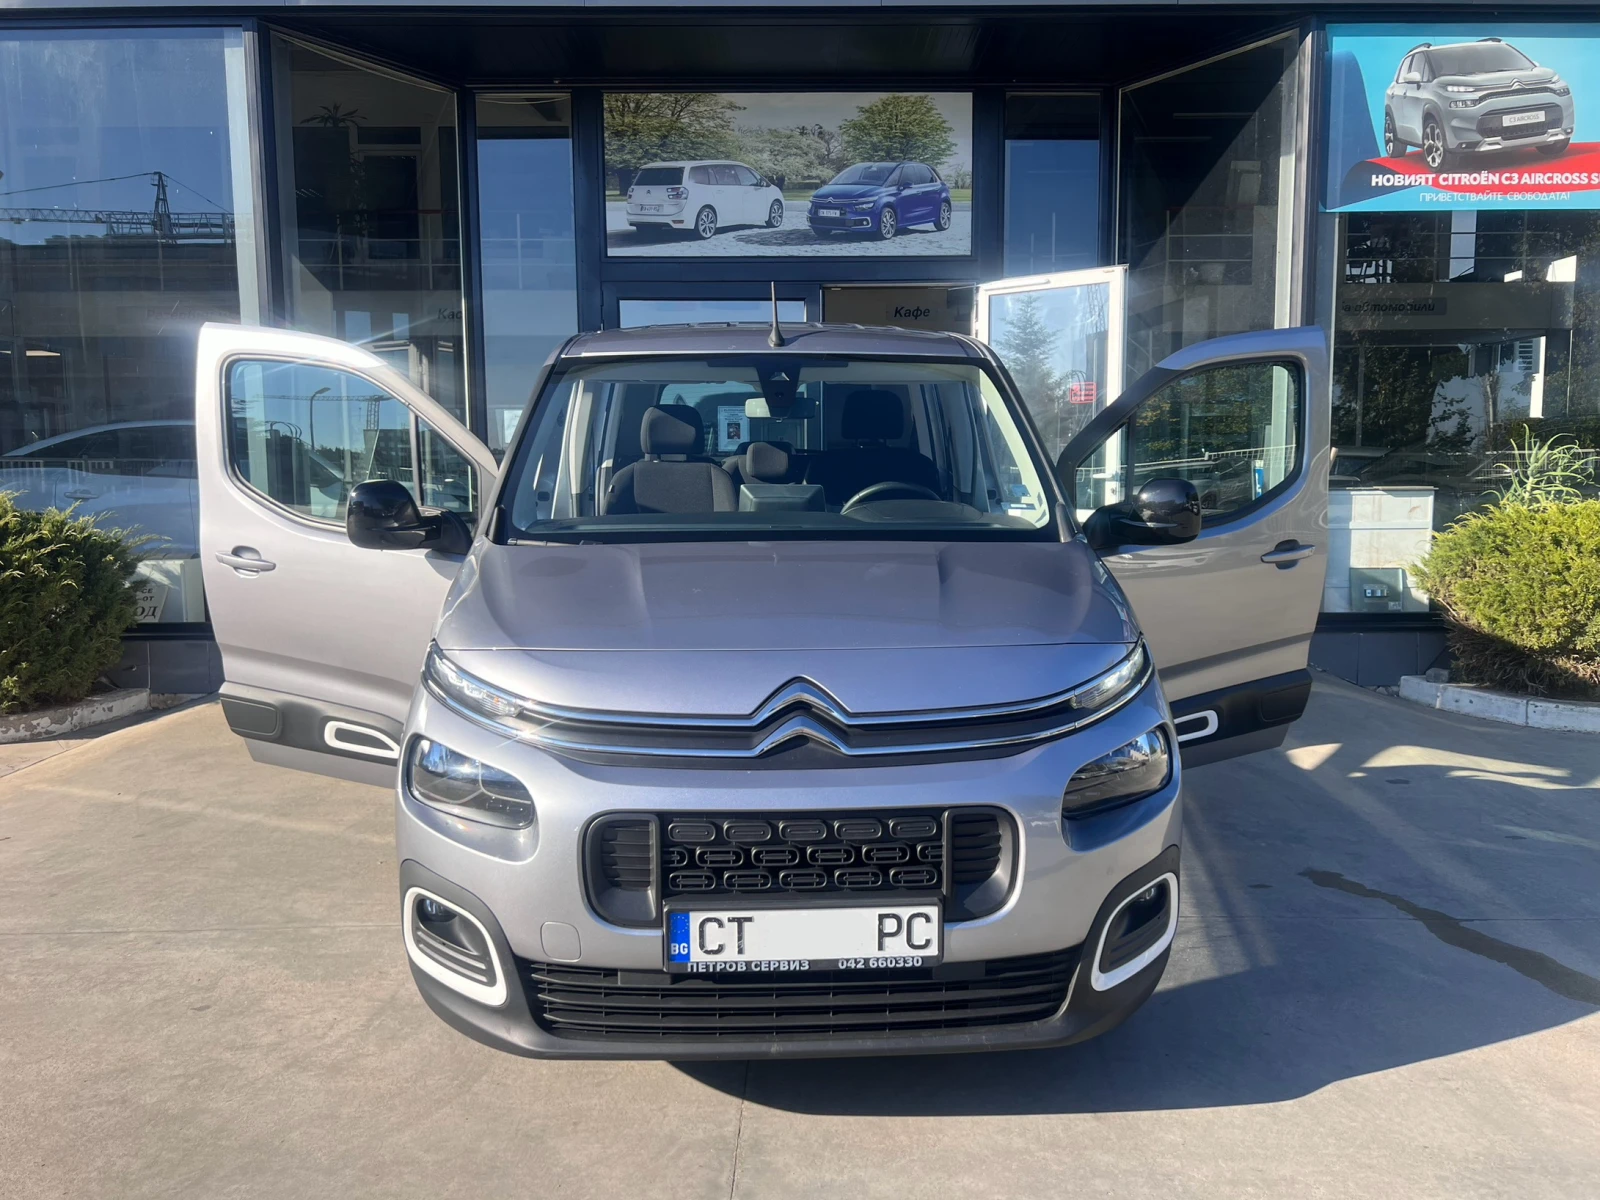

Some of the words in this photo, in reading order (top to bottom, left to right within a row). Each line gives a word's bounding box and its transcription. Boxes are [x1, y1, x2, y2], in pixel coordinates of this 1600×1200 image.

[1371, 174, 1435, 186] НОВИЯТ
[1438, 171, 1499, 185] CITROËN
[1501, 173, 1518, 185] C3
[1521, 172, 1588, 185] AIRCROSS
[1590, 172, 1600, 185] S
[1420, 190, 1503, 202] ПРИВЕТСТВАЙТЕ
[1507, 191, 1570, 201] СВОБОДАТА!
[893, 305, 930, 320] Кафе
[135, 606, 158, 619] ОД
[671, 943, 688, 955] BG
[687, 961, 747, 973] ПЕТРОВ
[751, 960, 810, 972] СЕРВИЗ
[838, 958, 865, 970] 042
[869, 956, 923, 969] 660330
